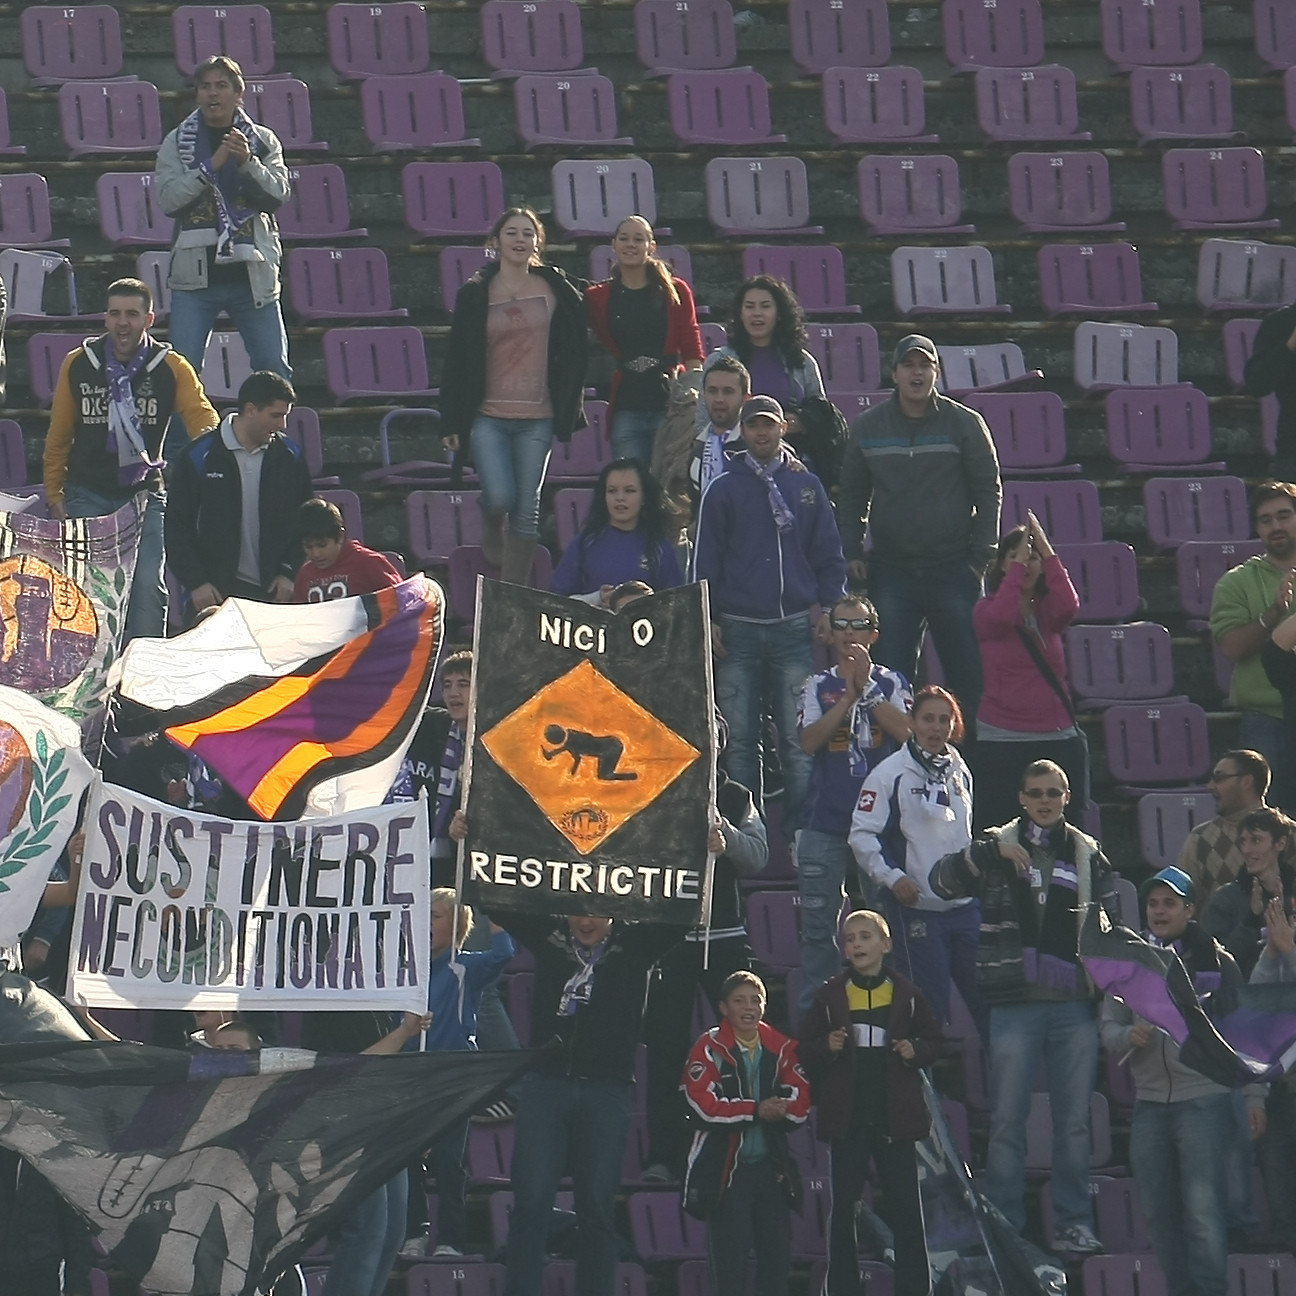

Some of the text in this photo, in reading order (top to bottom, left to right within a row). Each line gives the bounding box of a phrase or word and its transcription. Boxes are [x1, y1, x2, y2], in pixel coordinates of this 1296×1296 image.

[63, 5, 77, 18] 17
[522, 3, 537, 13] 20
[676, 2, 689, 11] 21
[214, 8, 227, 18] 18
[1020, 72, 1035, 81] 23
[1169, 72, 1183, 82] 24
[1209, 151, 1223, 161] 24
[749, 161, 763, 171] 21
[900, 159, 914, 169] 22
[1050, 157, 1064, 167] 23
[596, 165, 610, 174] 20
[1079, 246, 1094, 255] 23
[819, 327, 833, 337] 21
[1187, 482, 1203, 492] 23
[449, 495, 462, 505] 18
[538, 612, 656, 655] NICI O
[1146, 709, 1161, 719] 22
[468, 849, 701, 900] RESTRICTIE
[810, 1180, 823, 1190] 18
[452, 1269, 465, 1280] 15
